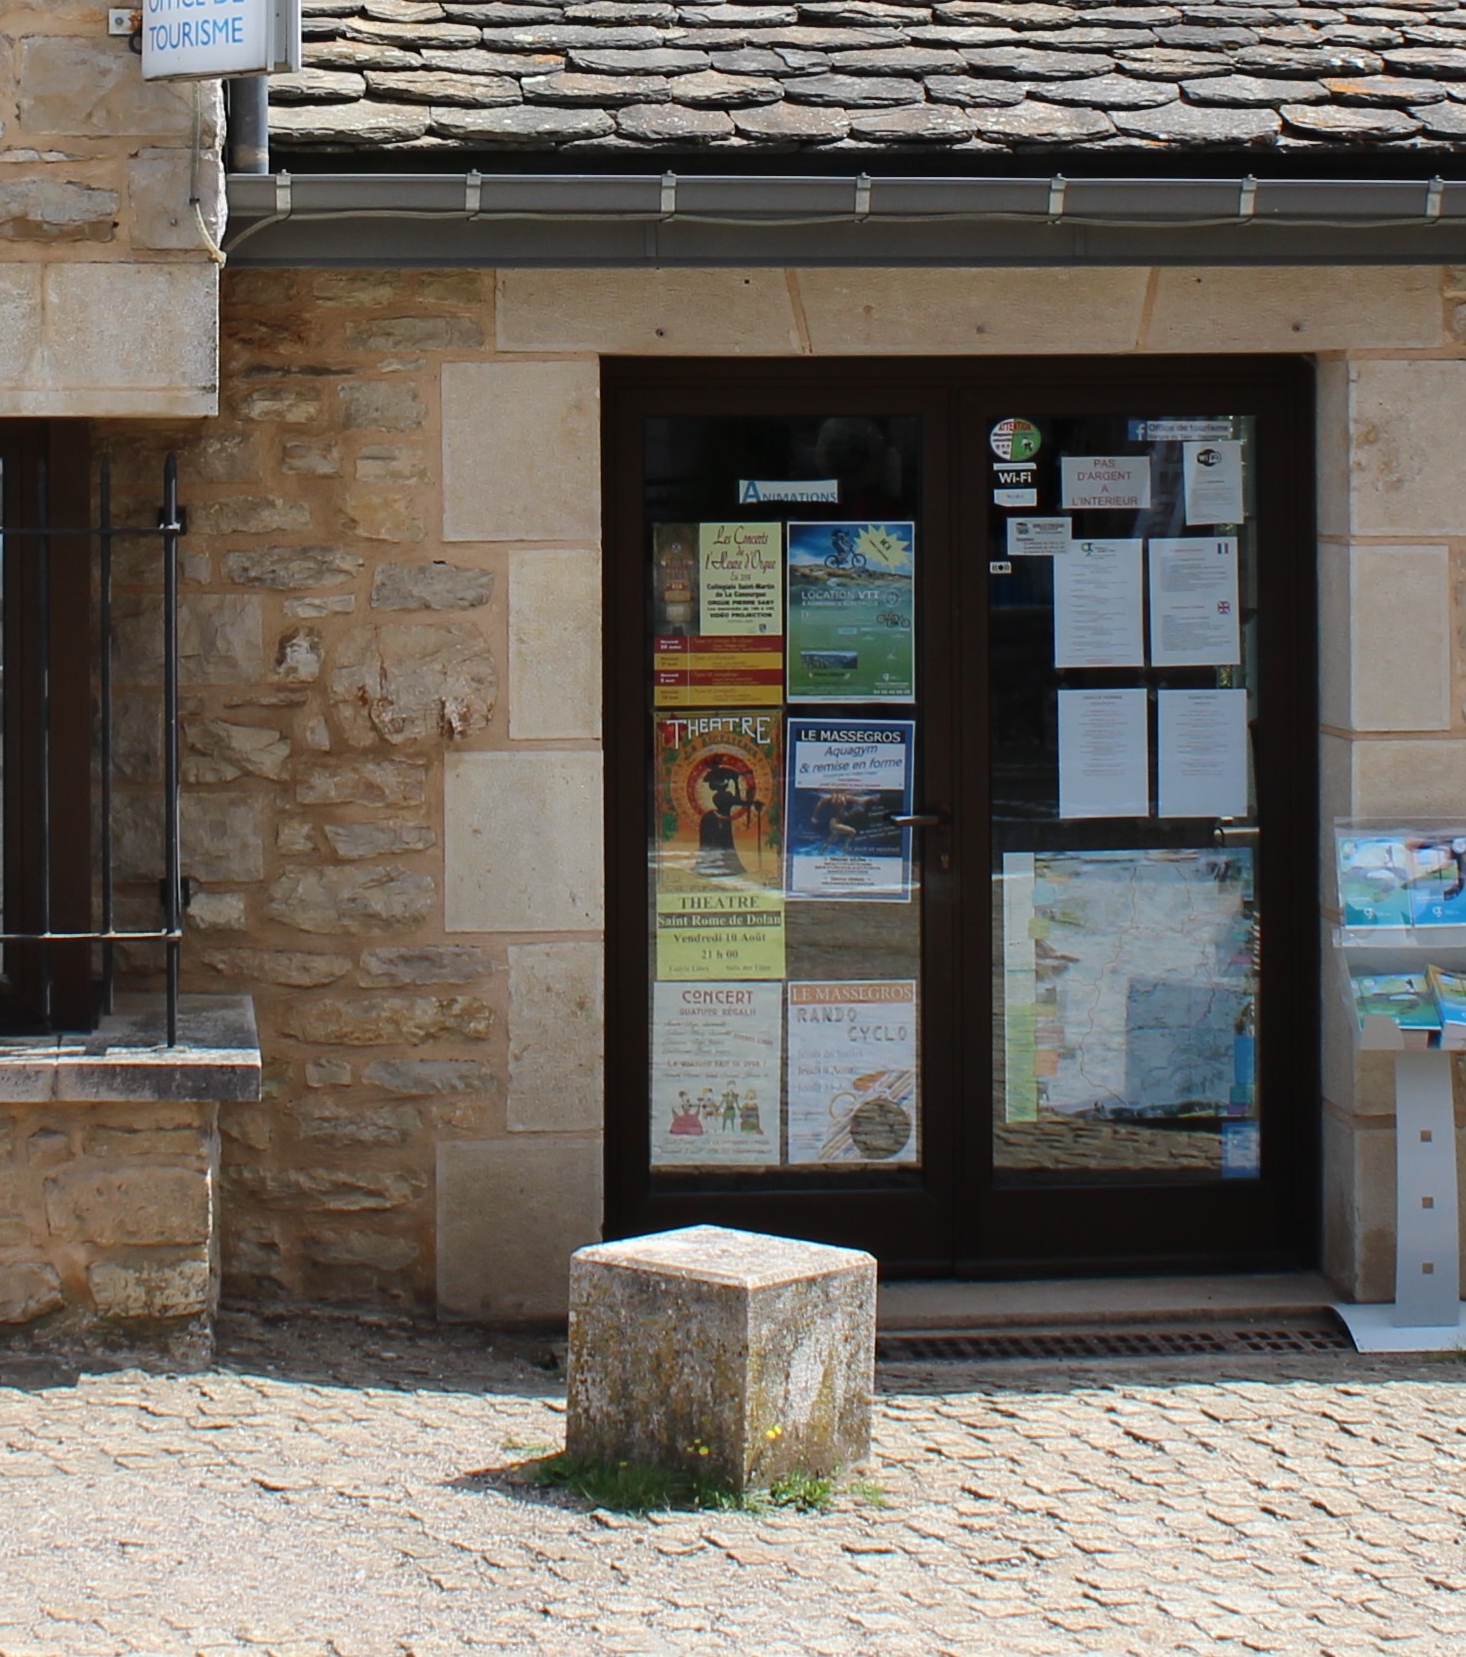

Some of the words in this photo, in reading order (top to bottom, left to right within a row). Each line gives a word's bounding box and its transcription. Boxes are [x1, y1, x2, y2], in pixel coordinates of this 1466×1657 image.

[148, 17, 244, 52] TOURISME
[1093, 458, 1116, 468] PAS
[998, 471, 1032, 484] Wi-Fi
[1077, 471, 1132, 481] D'ARGENT
[1101, 484, 1109, 493] A
[1071, 496, 1139, 506] L'INTERIEUR
[712, 525, 732, 545] Les
[800, 590, 855, 600] LOCATION
[857, 590, 880, 600] VTT
[800, 729, 817, 742] LE
[820, 730, 902, 743] MASSEGROS
[824, 744, 878, 759] Aquagym
[799, 762, 810, 774] &
[812, 760, 850, 773] remise
[851, 762, 867, 770] en
[868, 757, 903, 769] forme
[678, 895, 760, 910] THEATRE
[657, 914, 688, 927] Saint
[691, 914, 727, 926] Rome
[728, 914, 743, 926] de
[745, 913, 782, 926] Dolan
[673, 932, 722, 943] Vendredi
[792, 987, 813, 1001] LE
[815, 986, 912, 1001] MASSEGROS
[796, 1007, 858, 1023] RANDO
[848, 1026, 908, 1042] CYCLO
